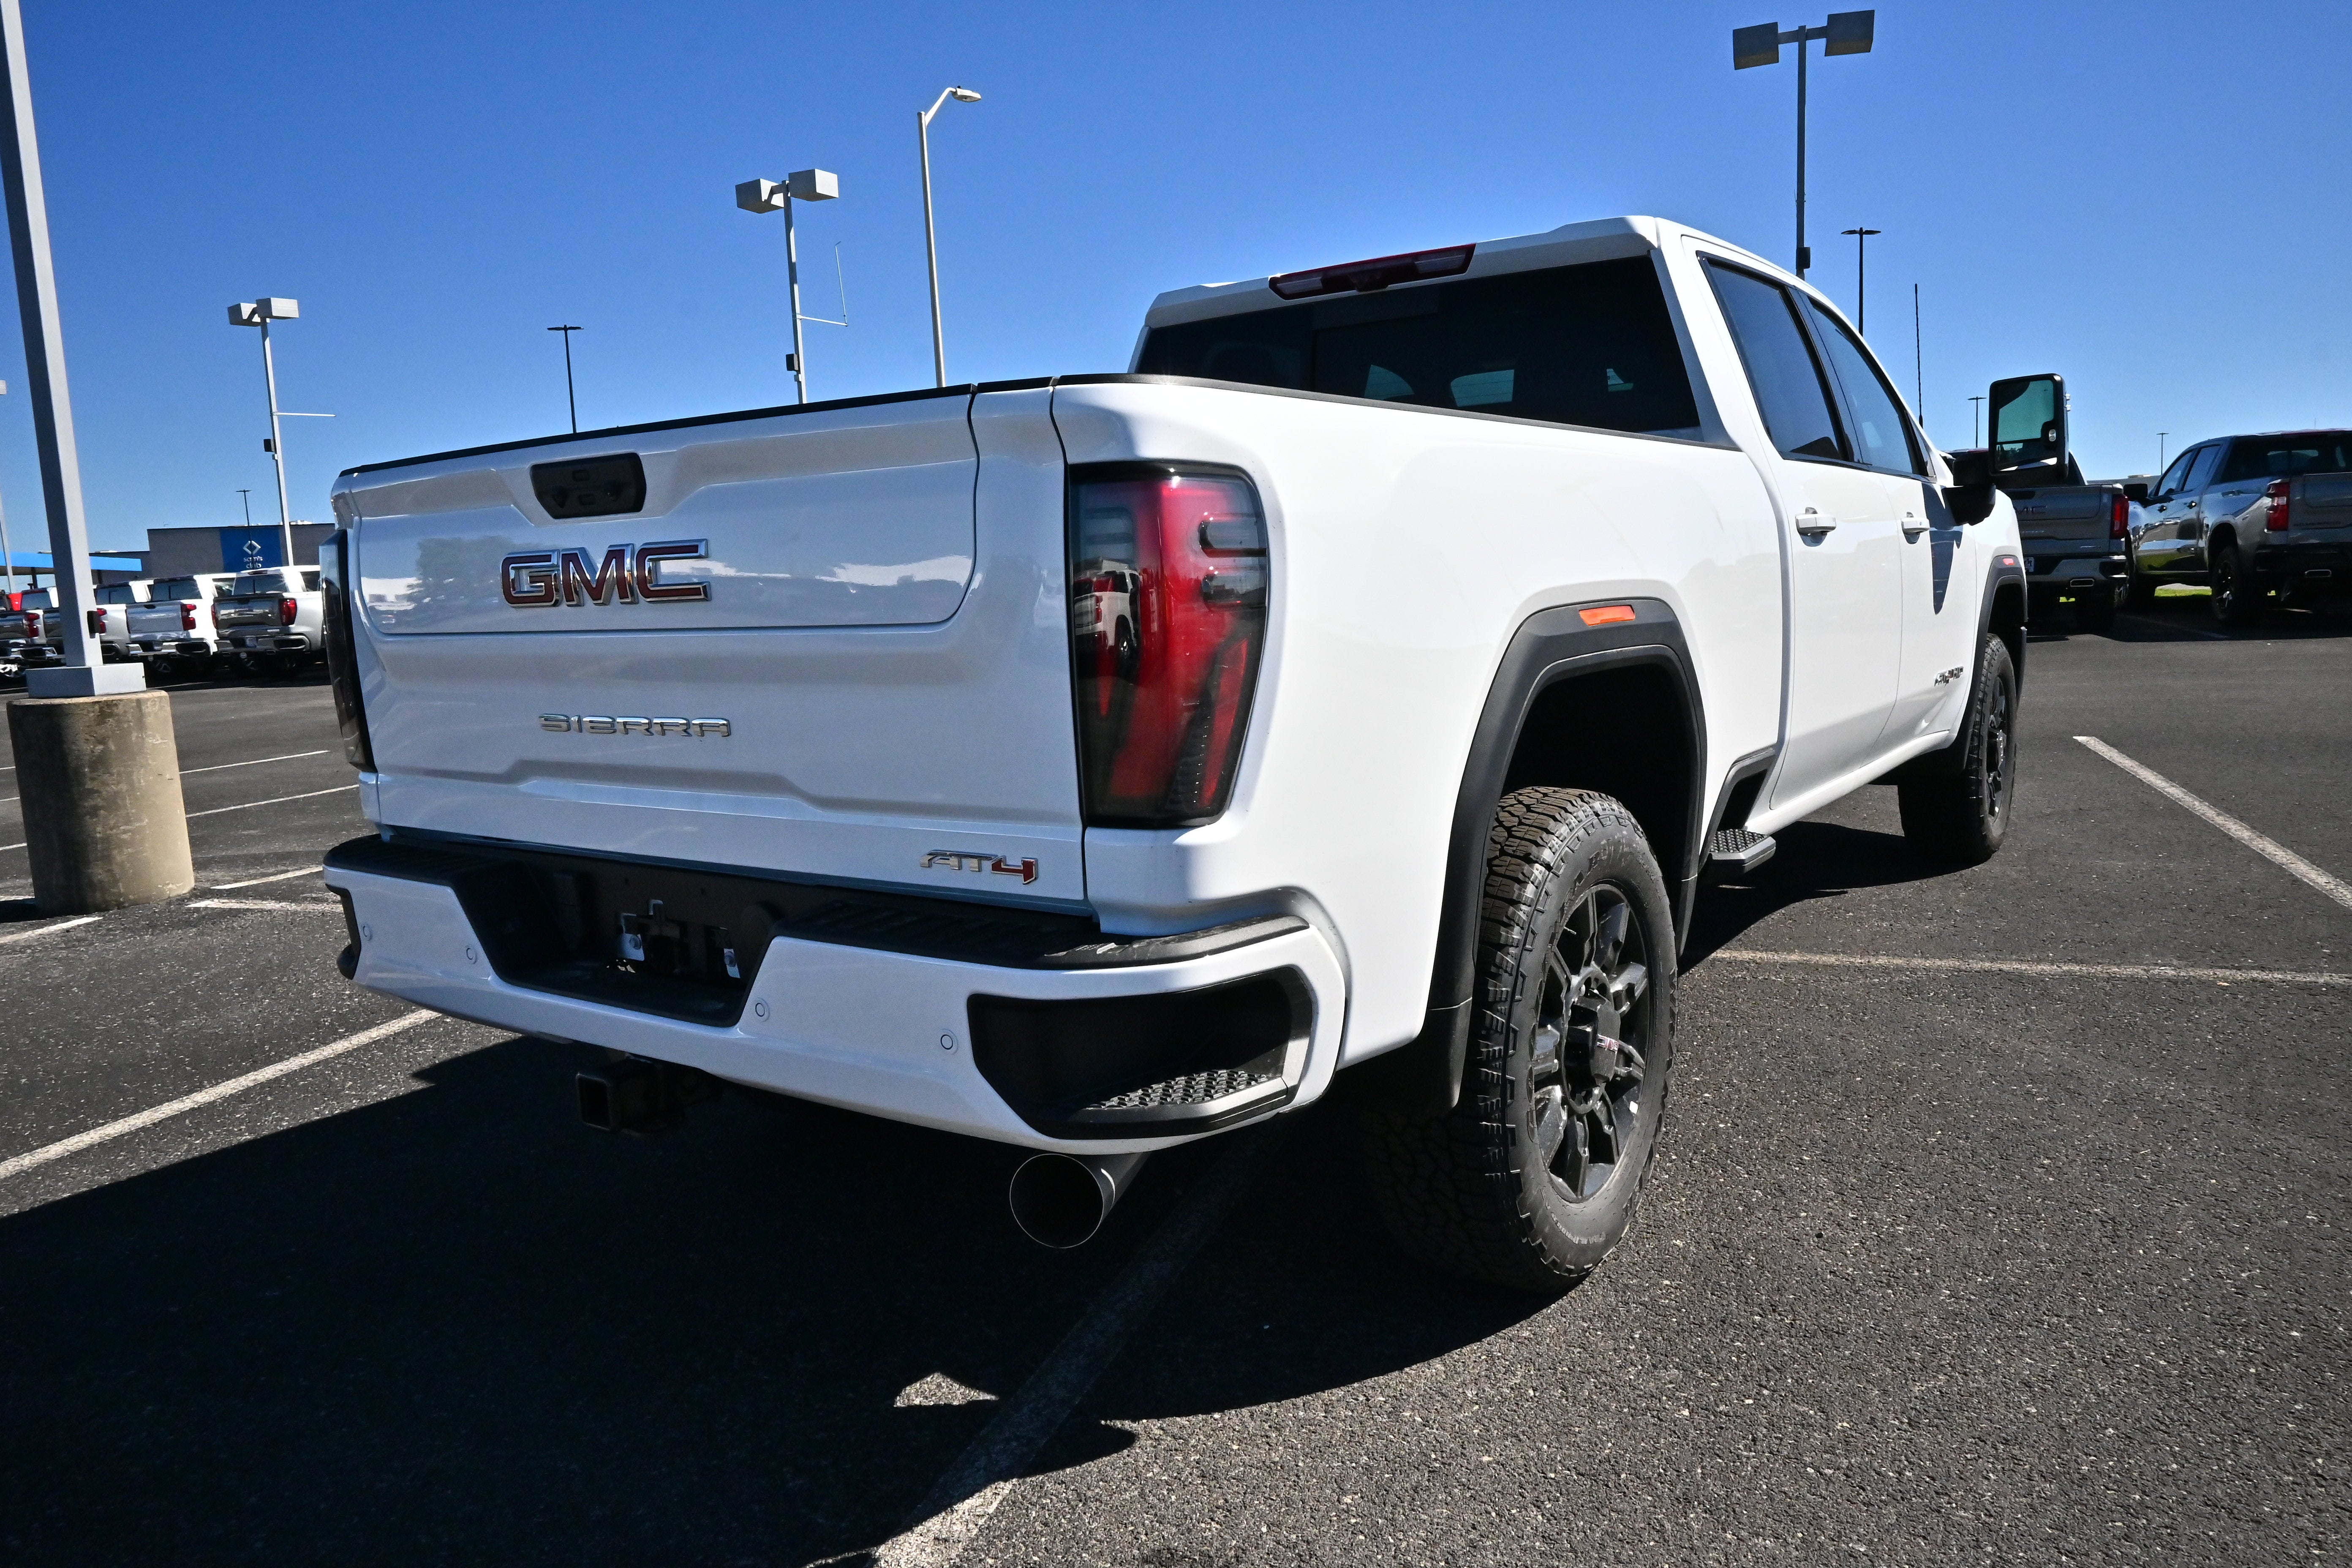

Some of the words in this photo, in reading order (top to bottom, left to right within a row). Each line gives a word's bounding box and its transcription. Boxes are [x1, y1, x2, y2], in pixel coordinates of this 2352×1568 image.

[501, 539, 711, 608] GMC
[538, 713, 732, 737] SIERRA
[920, 849, 1038, 885] AT4
